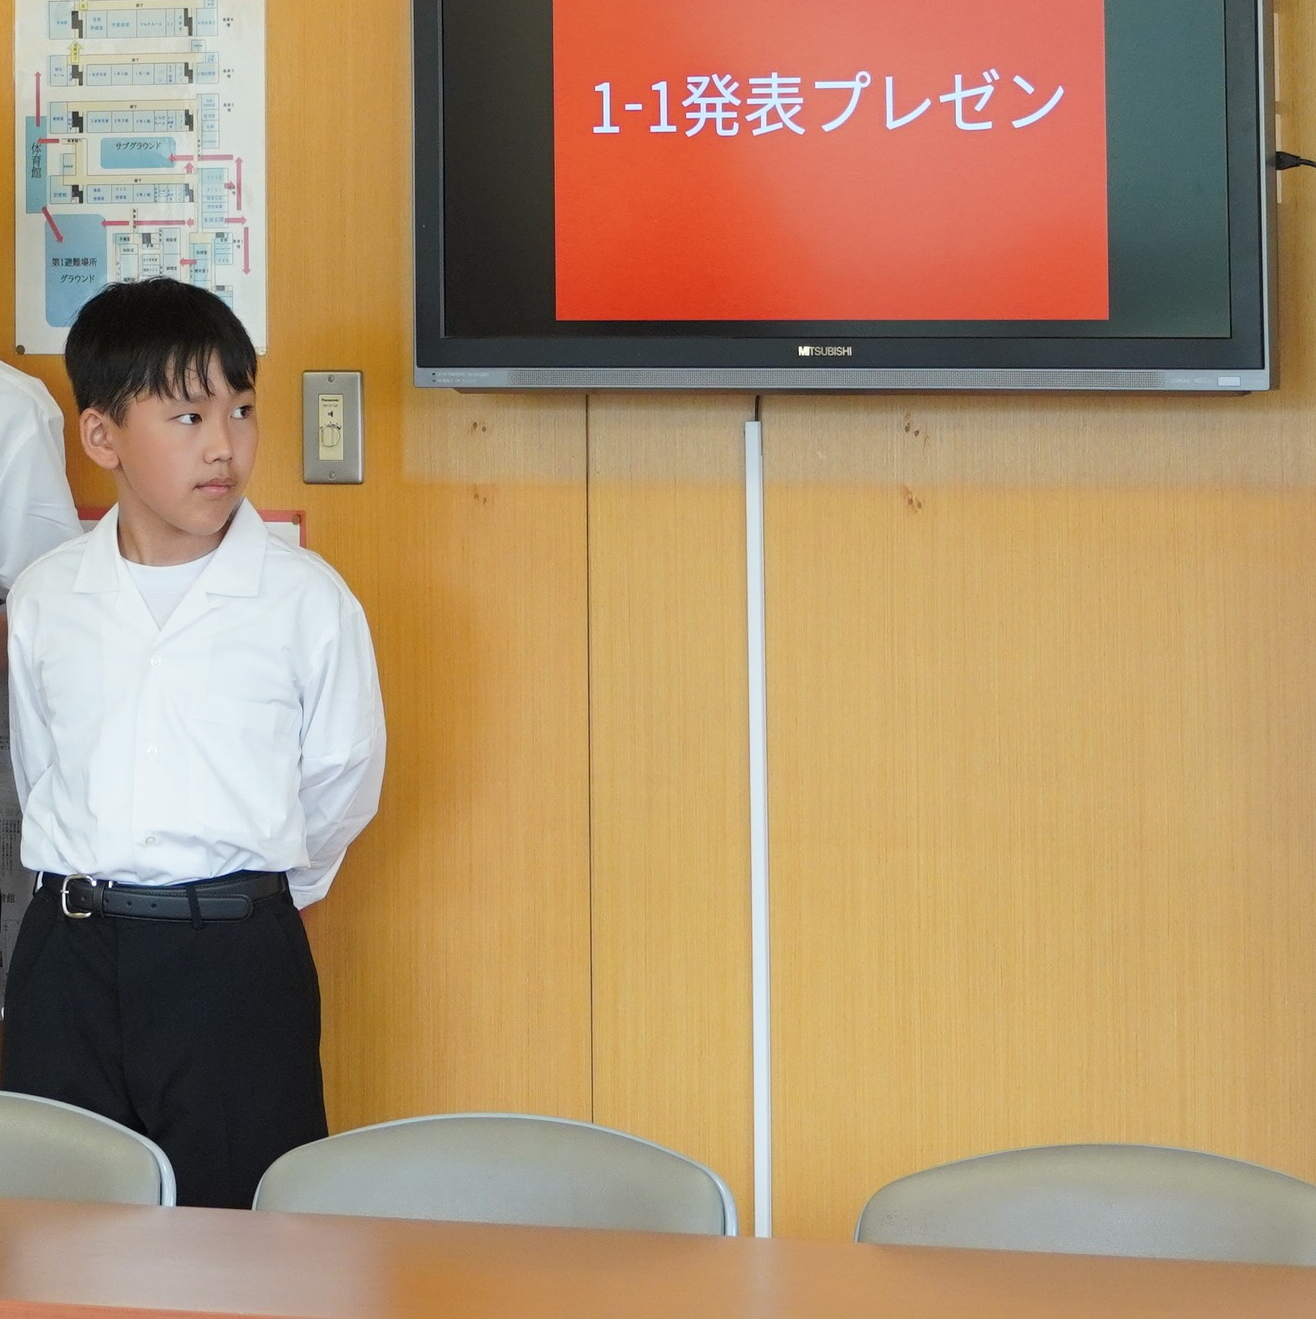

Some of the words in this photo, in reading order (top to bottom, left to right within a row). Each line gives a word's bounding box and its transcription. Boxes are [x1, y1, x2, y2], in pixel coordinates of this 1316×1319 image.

[591, 68, 1067, 138] 1-1発表プレゼン
[115, 142, 161, 150] サブグラウンド
[60, 274, 95, 283] グラウンド
[798, 346, 852, 356] MITSUBISHI
